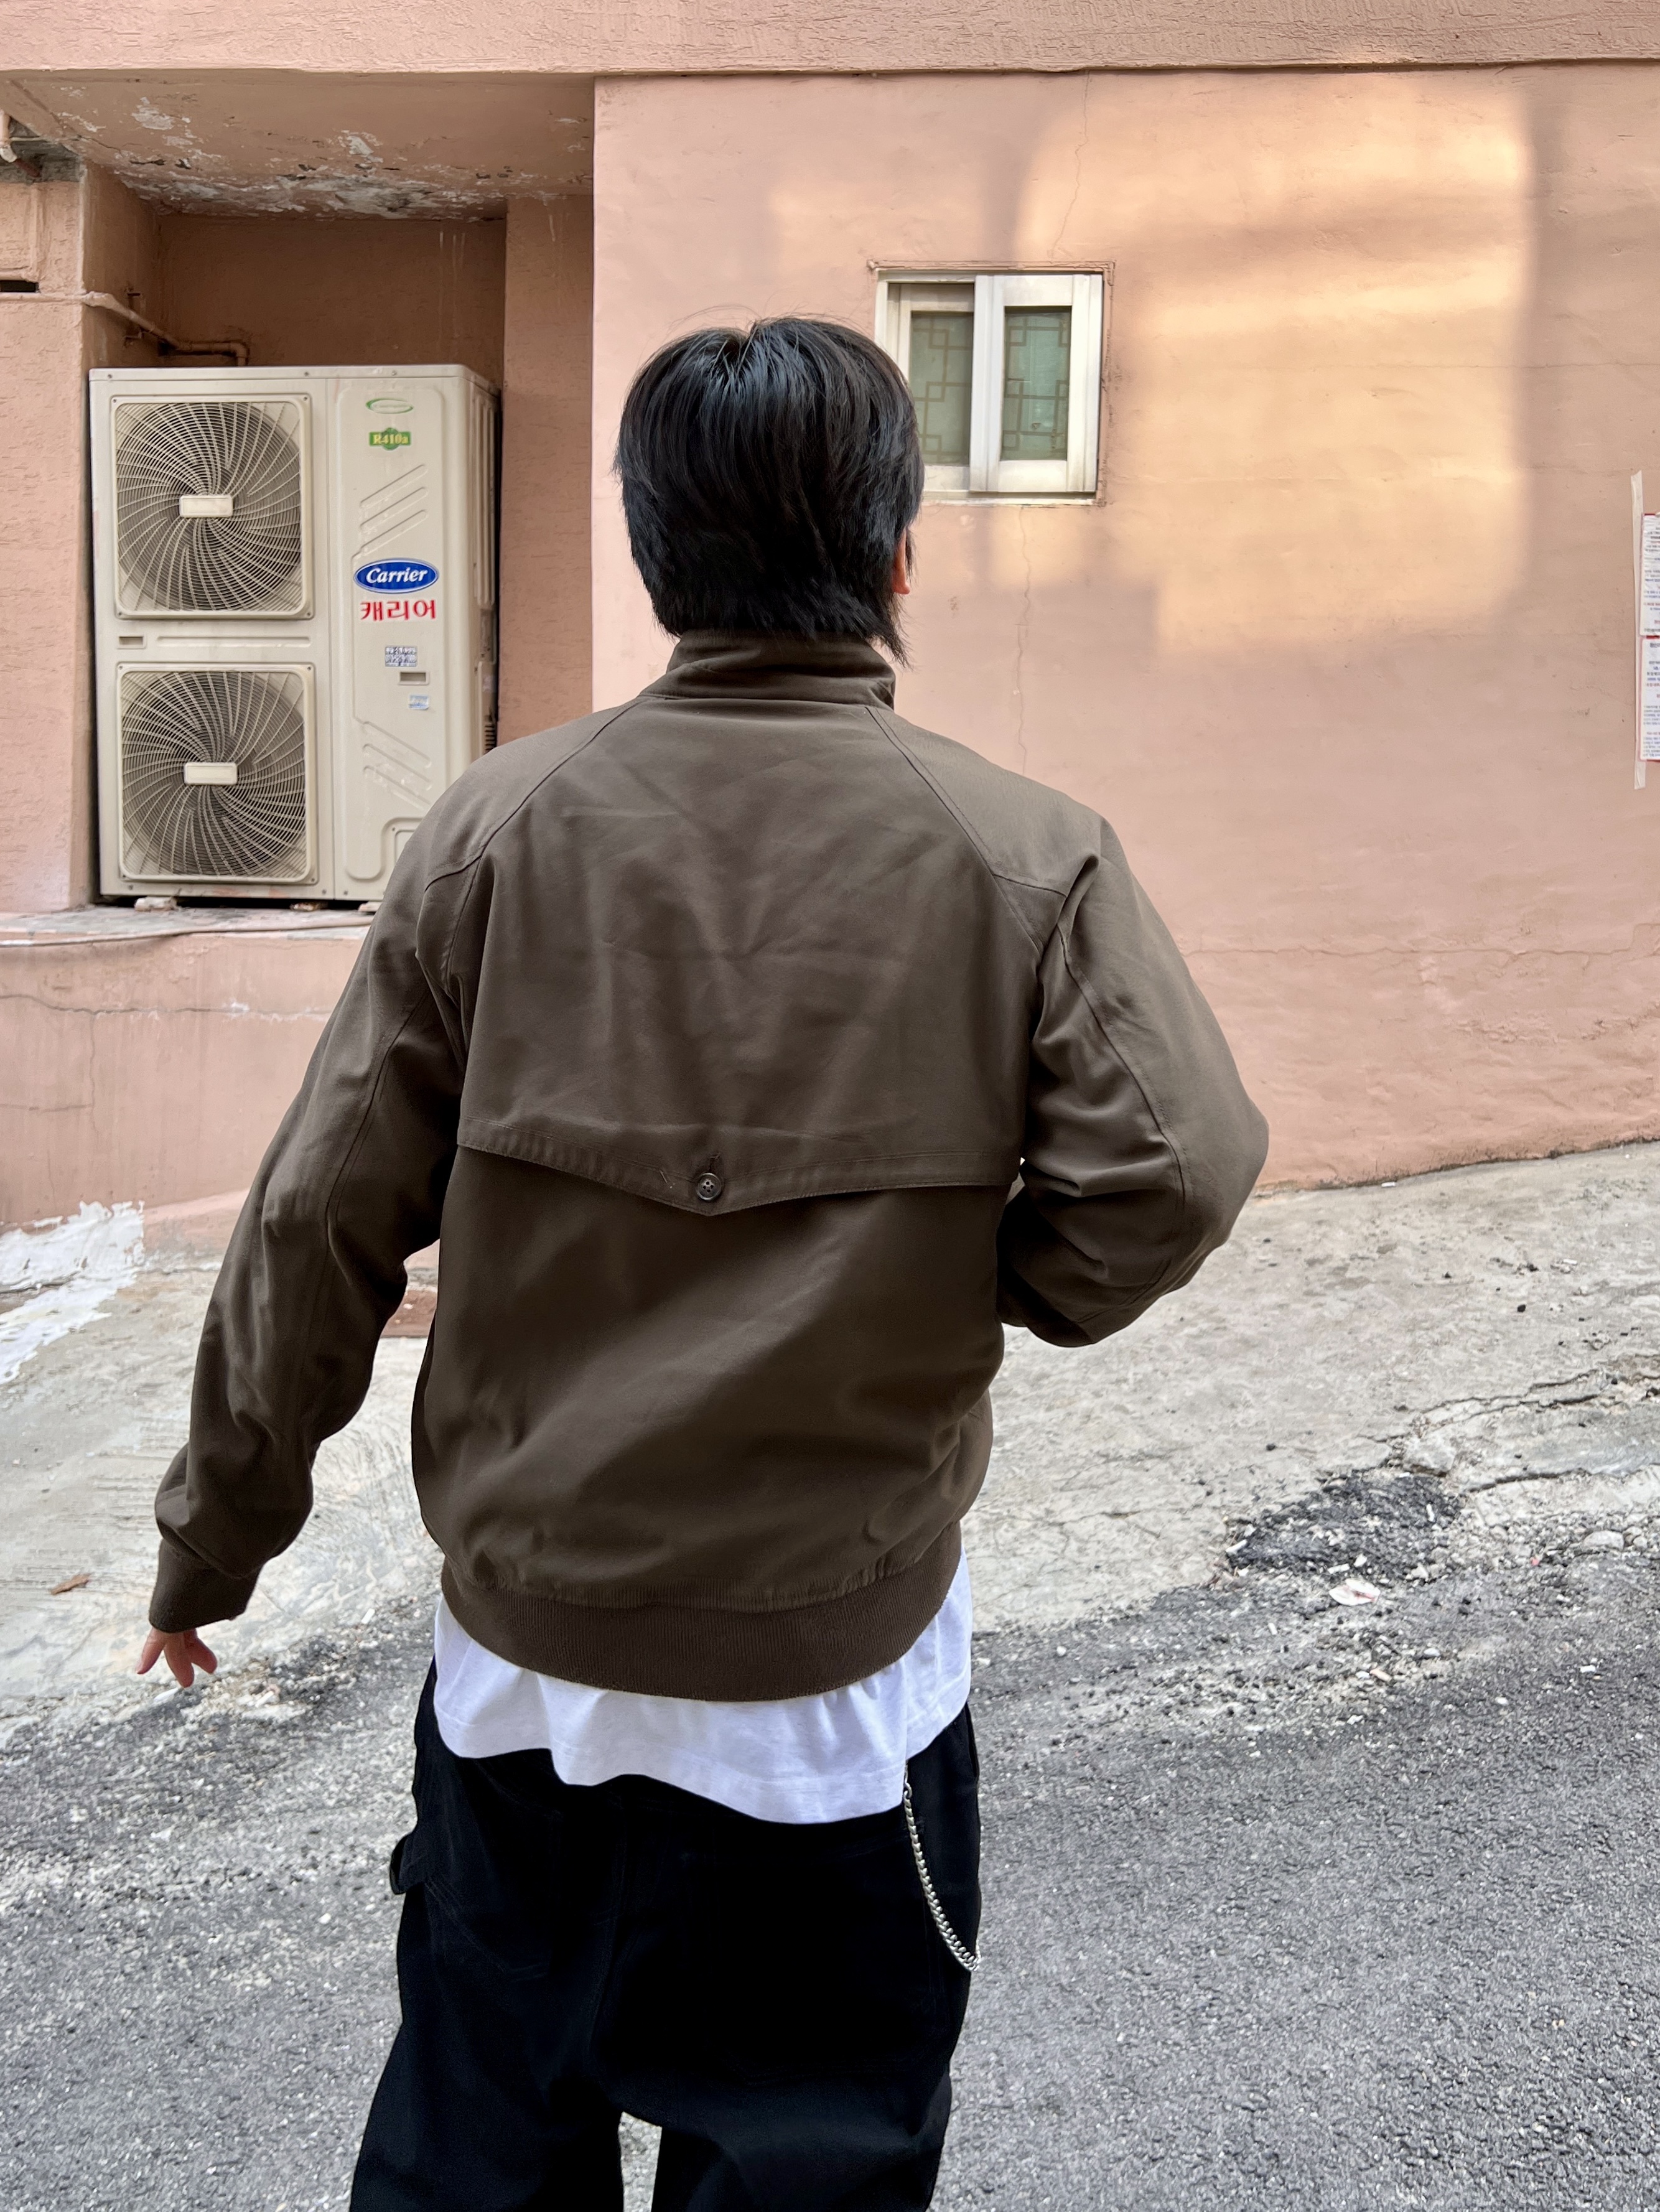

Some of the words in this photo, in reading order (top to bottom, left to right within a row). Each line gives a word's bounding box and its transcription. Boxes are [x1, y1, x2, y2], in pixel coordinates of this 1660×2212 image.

[373, 434, 409, 444] R410a
[366, 567, 428, 584] Carrier
[360, 599, 436, 621] 캐리어
